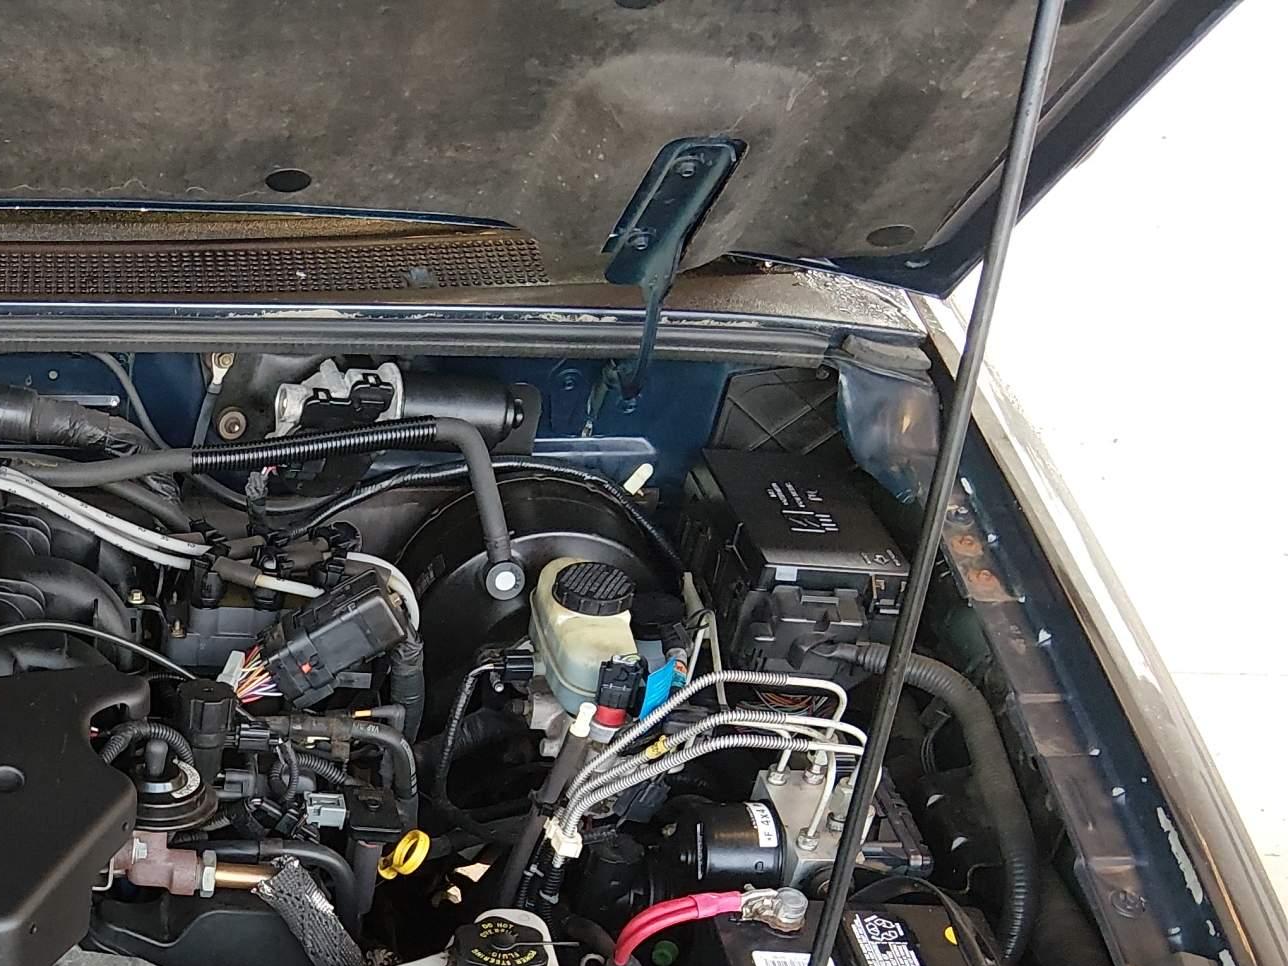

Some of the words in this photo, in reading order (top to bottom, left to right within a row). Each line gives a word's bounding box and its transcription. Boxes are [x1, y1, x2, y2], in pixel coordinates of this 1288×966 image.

[472, 949, 512, 966] STEERING
[492, 951, 520, 959] FLUID
[515, 950, 537, 965] POWER
